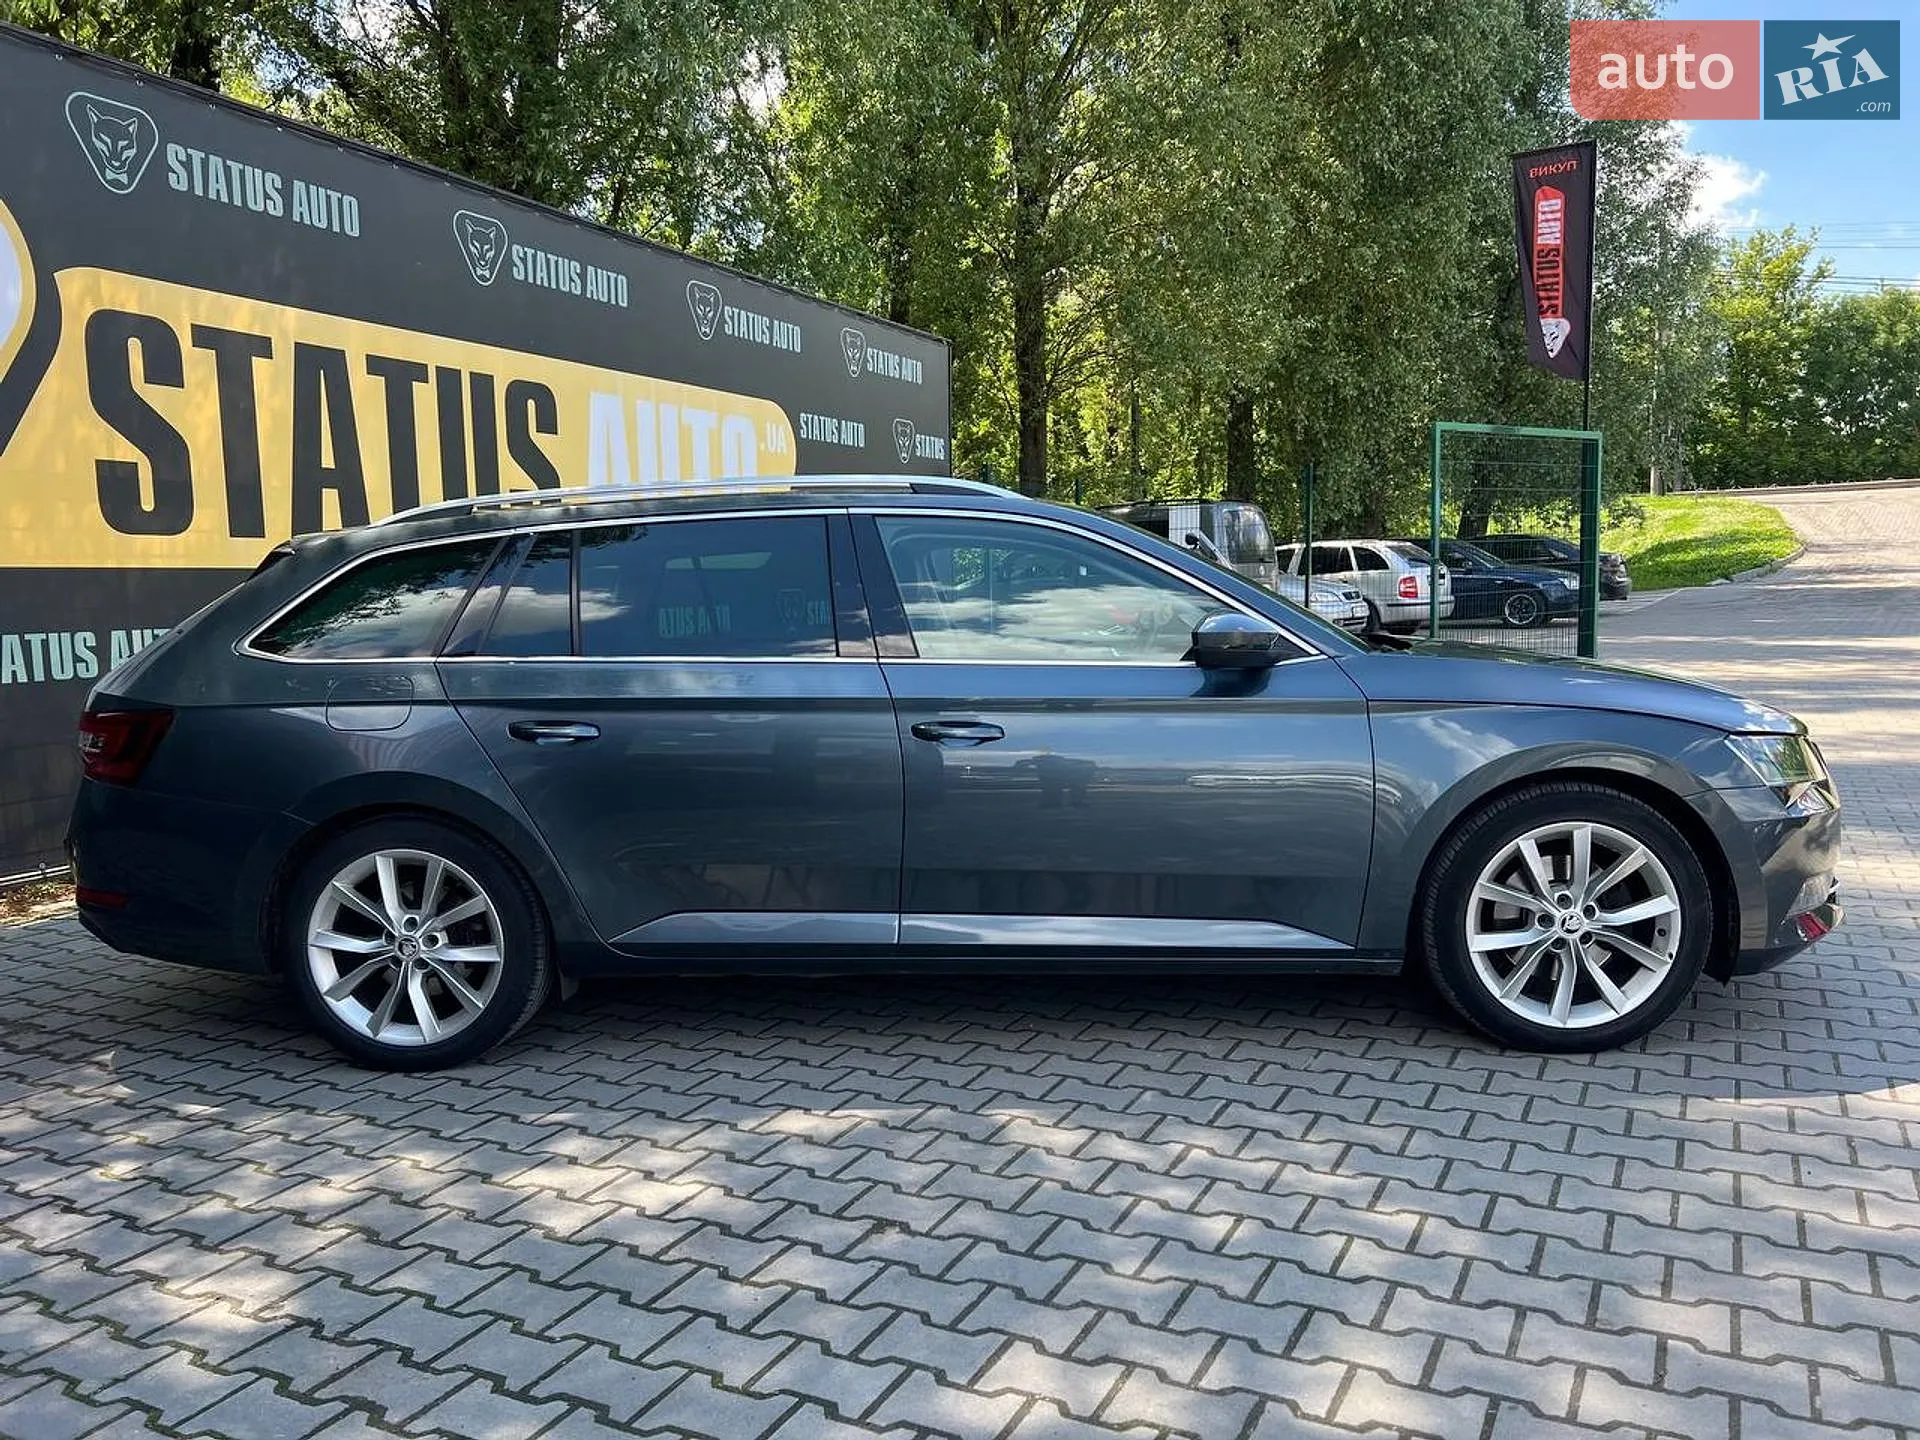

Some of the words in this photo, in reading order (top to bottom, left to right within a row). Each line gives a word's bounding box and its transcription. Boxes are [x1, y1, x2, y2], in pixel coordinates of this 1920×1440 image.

[166, 142, 284, 218] STATUS
[292, 180, 361, 237] AUTO
[1529, 160, 1577, 178] ВИКУП
[1537, 199, 1562, 244] AUTO
[511, 244, 582, 295] STATUS
[586, 265, 628, 308] AUTO
[1536, 247, 1560, 315] STATUS
[724, 306, 770, 345] STATUS
[773, 320, 800, 353] AUTO
[866, 347, 900, 378] STATUS
[901, 356, 923, 385] AUTO
[84, 309, 561, 538] STATUS
[588, 391, 758, 487] AUTO
[800, 412, 839, 444] STATUS
[840, 420, 865, 448] AUTO
[915, 434, 945, 460] STATUS
